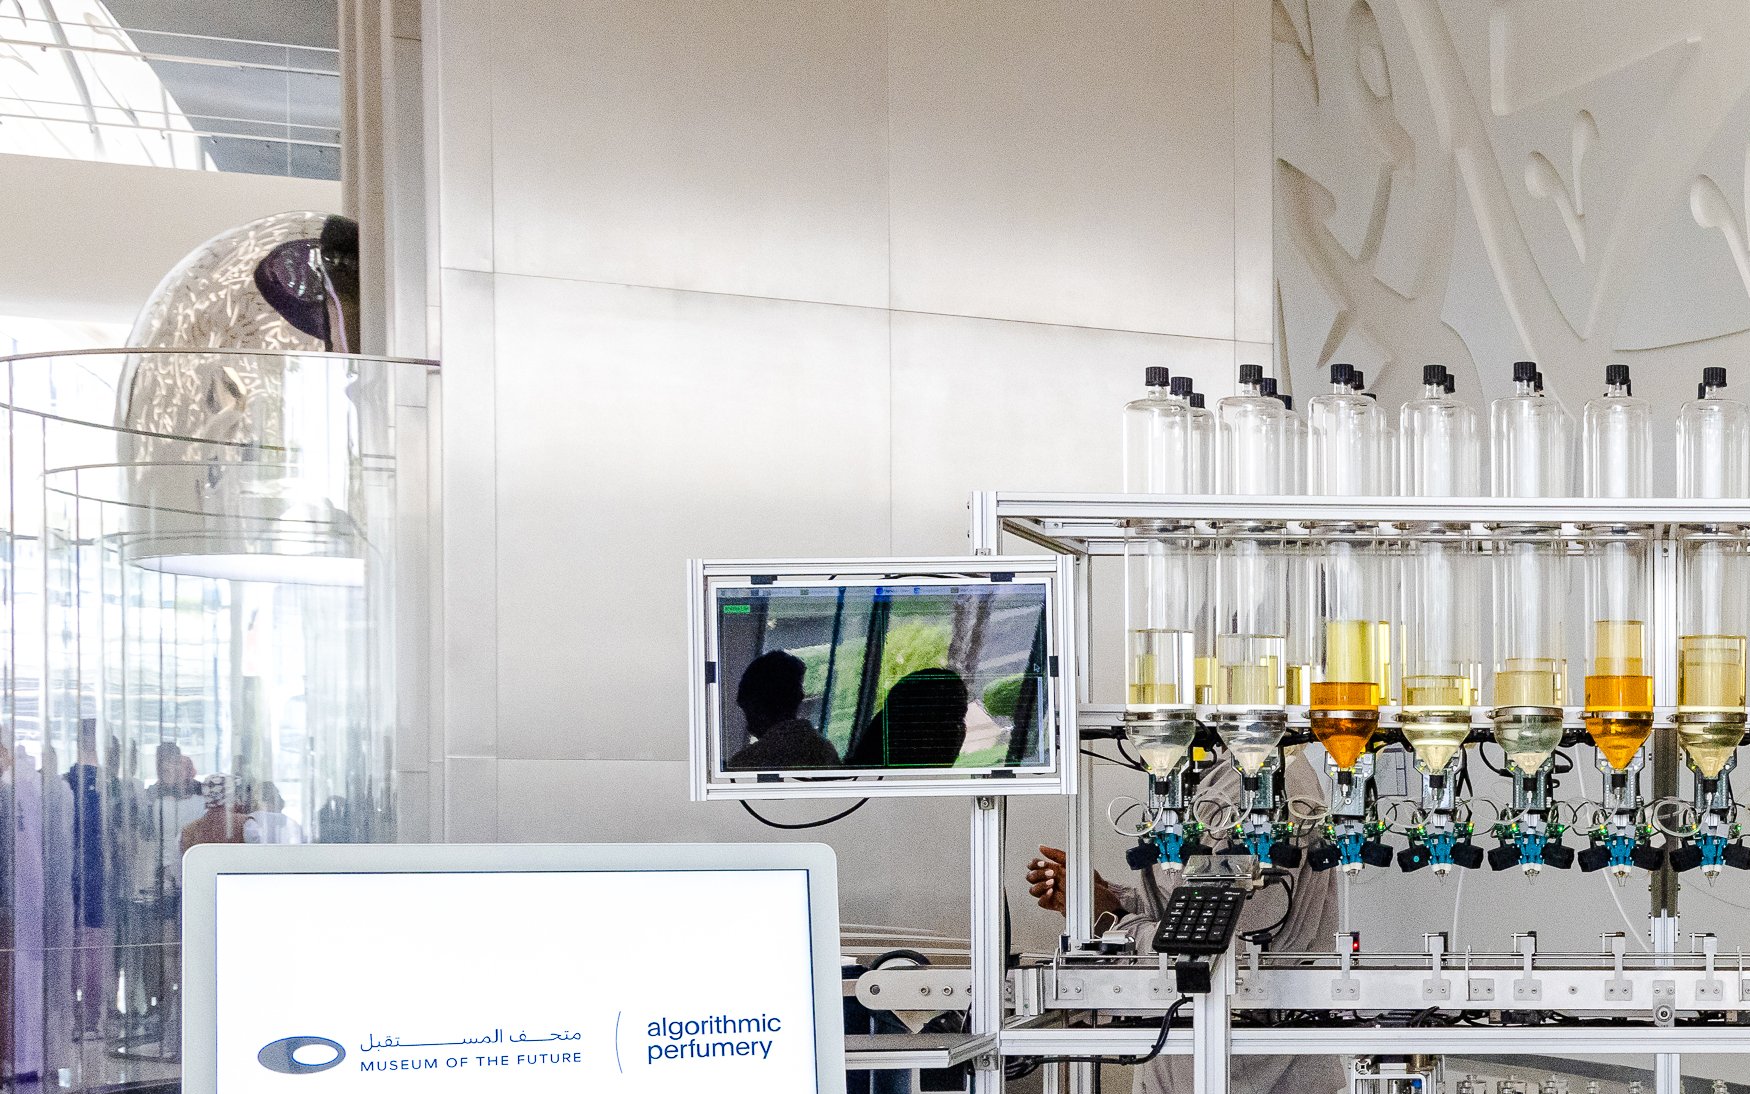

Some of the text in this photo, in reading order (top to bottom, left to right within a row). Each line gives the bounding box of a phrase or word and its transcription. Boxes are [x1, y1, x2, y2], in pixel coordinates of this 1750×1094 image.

[508, 1029, 582, 1043] متحف
[647, 1013, 782, 1041] algorithmic
[360, 1052, 582, 1072] MUSEUM OF THE FUTURE
[647, 1038, 773, 1065] perfumery
